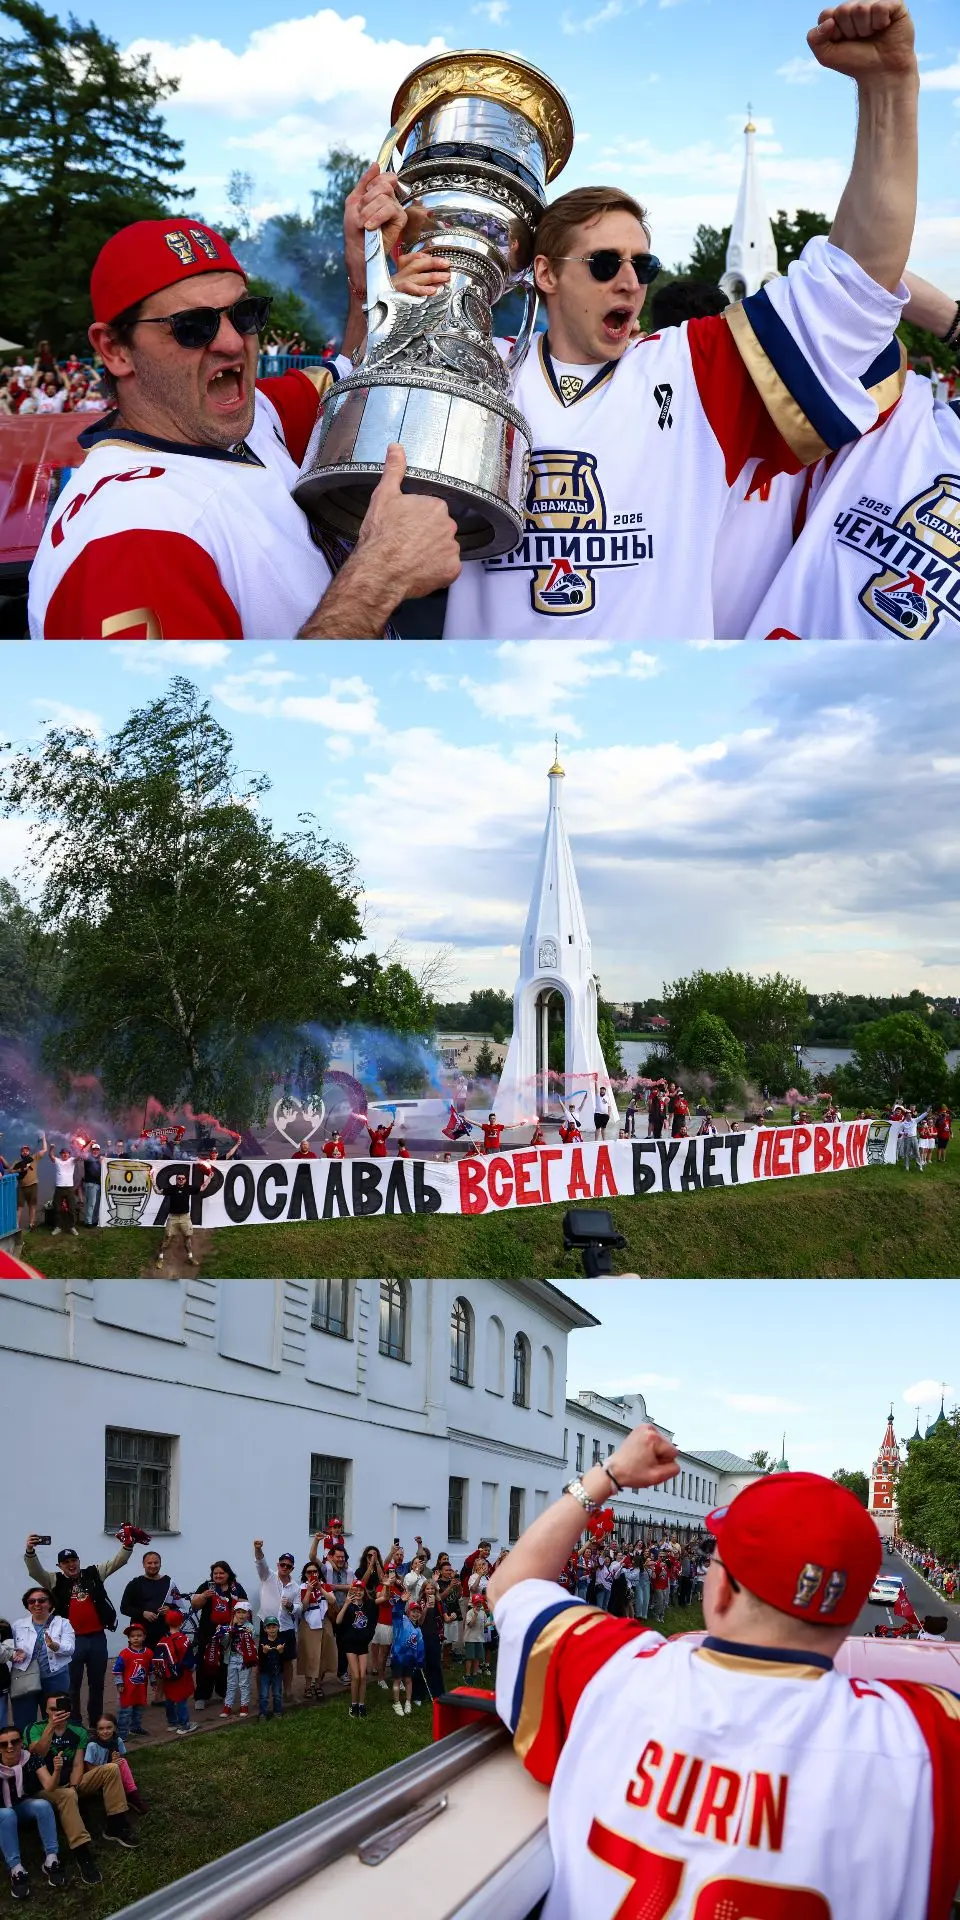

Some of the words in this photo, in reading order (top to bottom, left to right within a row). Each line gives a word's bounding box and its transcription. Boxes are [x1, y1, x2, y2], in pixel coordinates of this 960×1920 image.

[531, 500, 588, 513] ДВАЖДЫ
[613, 512, 643, 525] 2026
[858, 496, 892, 516] 2025
[918, 513, 960, 545] ДВАЖ
[482, 534, 654, 564] МПИОНЫ
[153, 1161, 442, 1225] ЯРОСЛАВЛЬ
[458, 1145, 619, 1214] ВСЕГДА
[632, 1134, 746, 1194] БУДЕТ
[753, 1124, 869, 1179] ПЕРВЫМ
[625, 1739, 789, 1853] SURN
